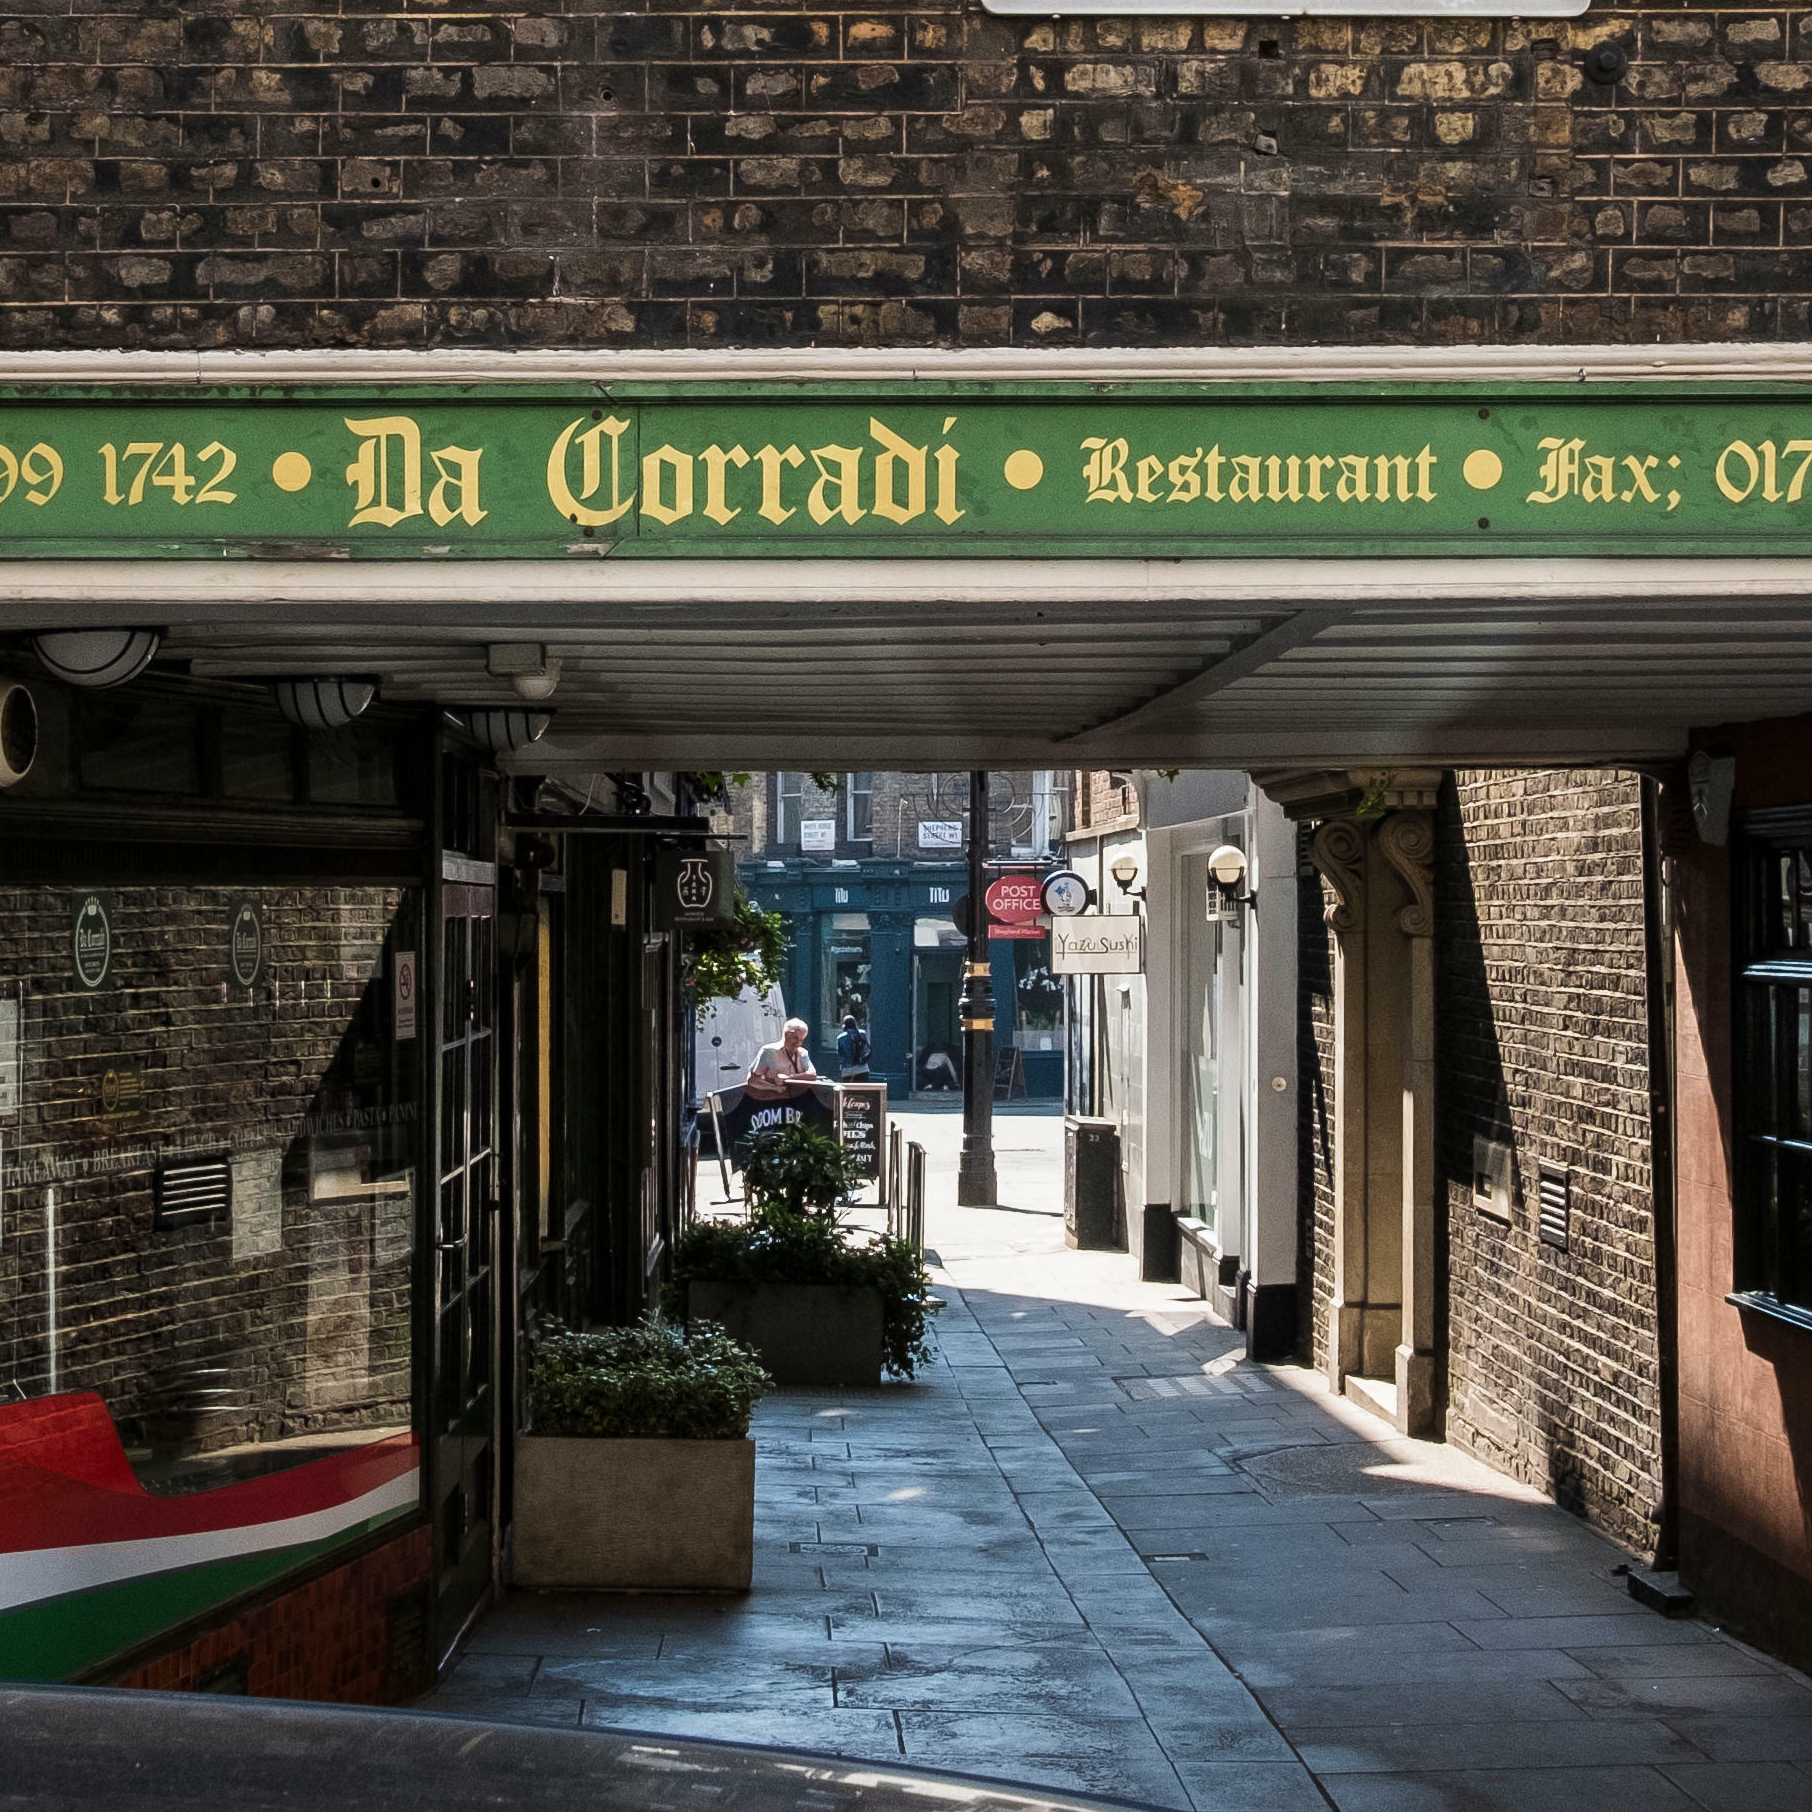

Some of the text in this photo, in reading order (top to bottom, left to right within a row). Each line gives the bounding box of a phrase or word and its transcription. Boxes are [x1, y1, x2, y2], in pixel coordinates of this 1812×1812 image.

[98, 441, 238, 507] 1742
[343, 415, 489, 528] Da
[547, 415, 966, 528] Corradi
[1079, 437, 1439, 505] Restaurant
[1001, 885, 1037, 898] POST
[992, 898, 1041, 911] OFFICE
